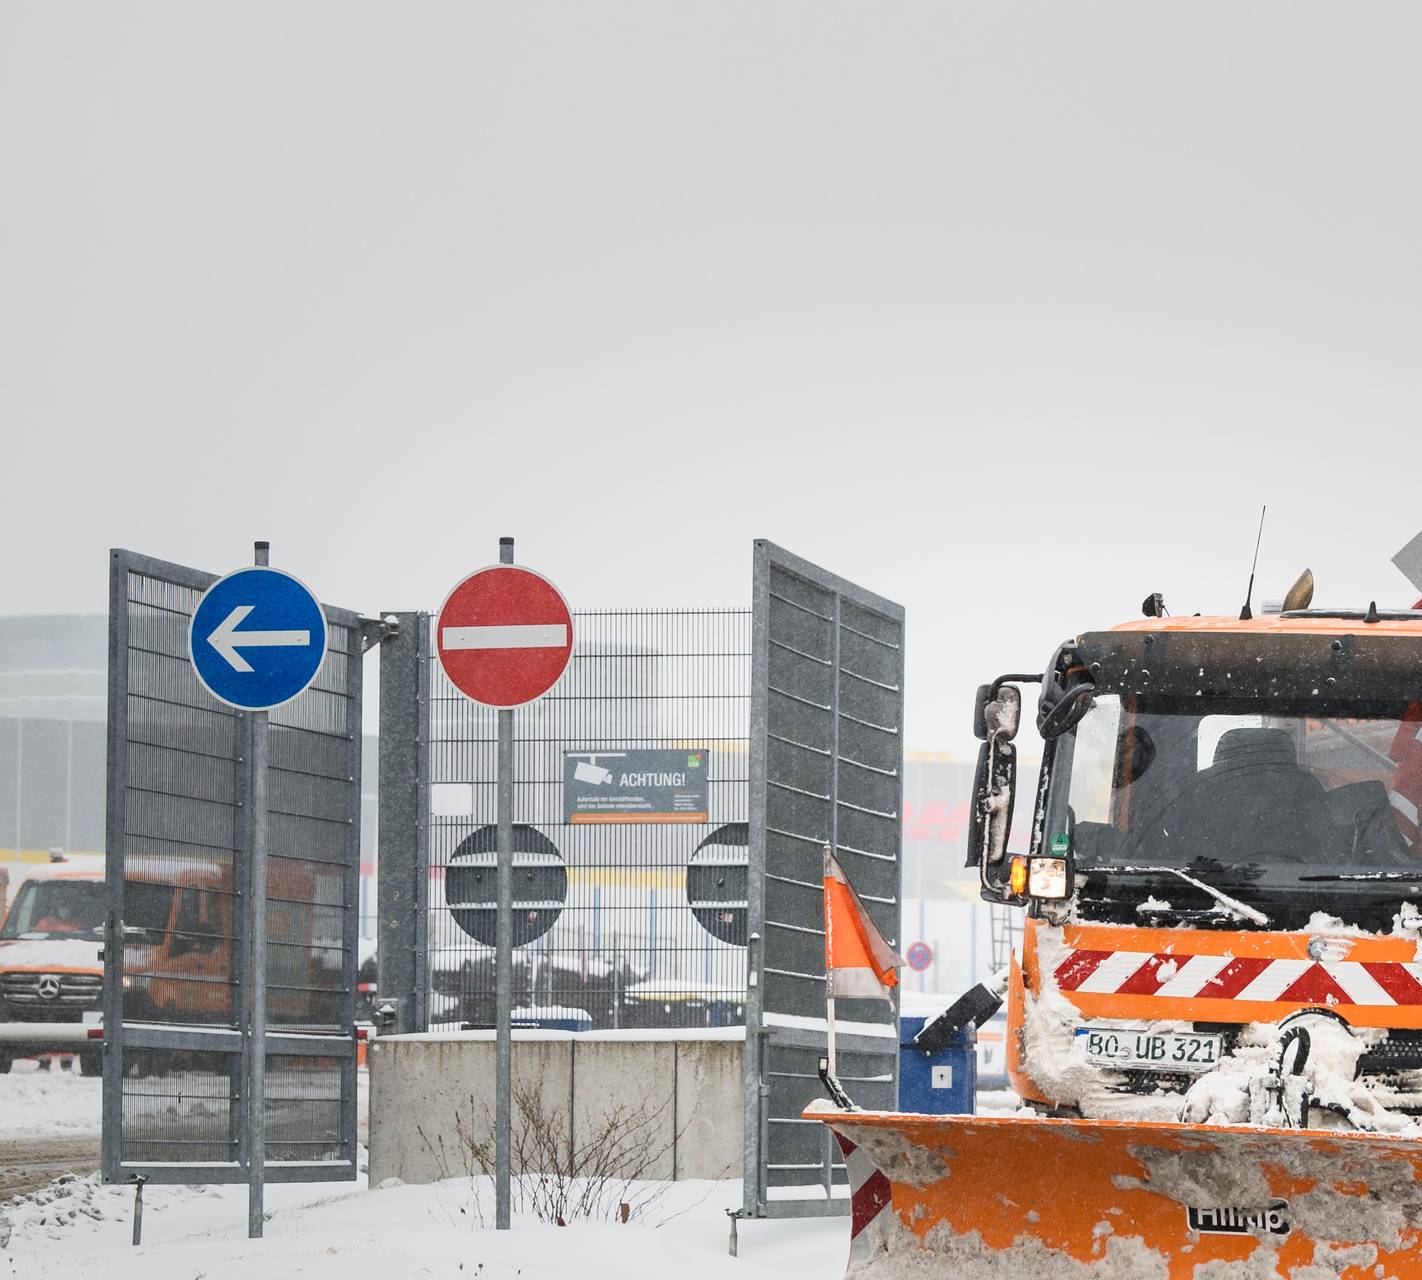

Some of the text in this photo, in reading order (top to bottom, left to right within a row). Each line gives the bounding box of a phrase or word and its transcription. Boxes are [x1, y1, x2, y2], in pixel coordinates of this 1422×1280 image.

[620, 772, 686, 787] ACHTUNG!
[1089, 1033, 1215, 1063] BO UB 321
